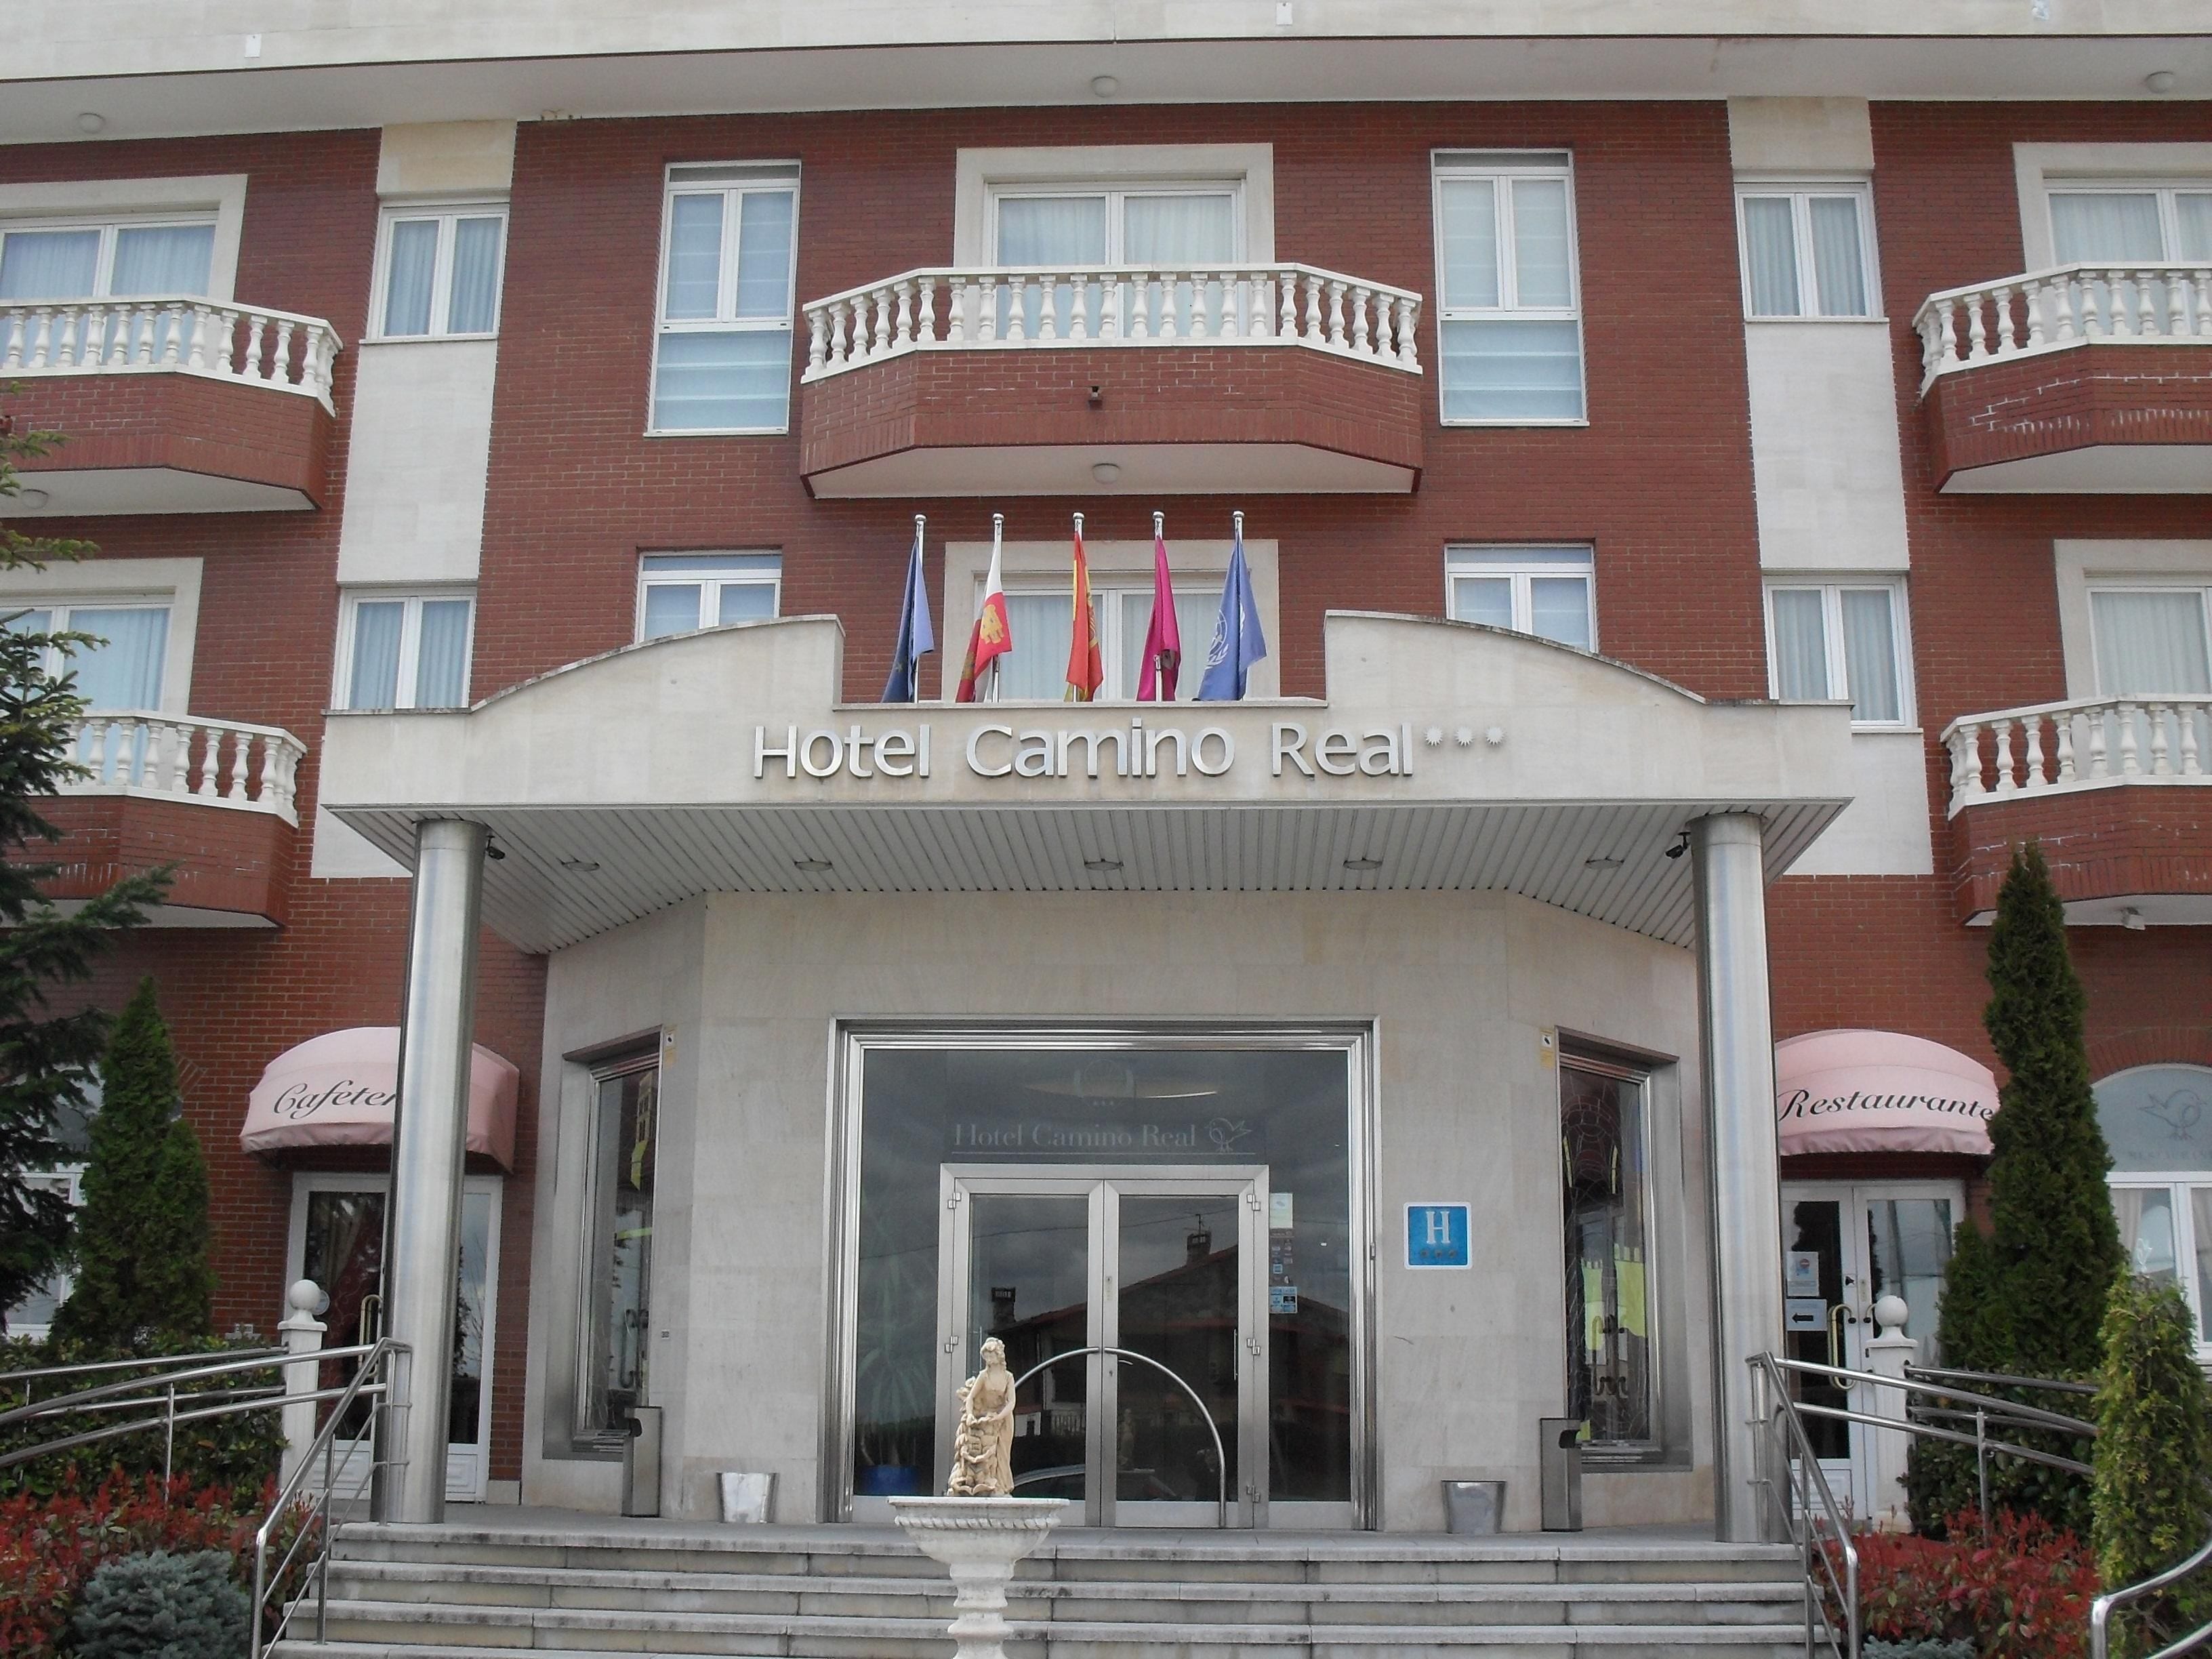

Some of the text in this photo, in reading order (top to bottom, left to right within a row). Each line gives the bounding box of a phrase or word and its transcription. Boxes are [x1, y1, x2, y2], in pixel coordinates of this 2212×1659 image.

[752, 717, 1414, 780] Hotel Camino Real
[1777, 1088, 1994, 1122] Restaurante
[954, 1122, 1196, 1147] Hotel Camino Real
[1425, 1210, 1451, 1245] H
